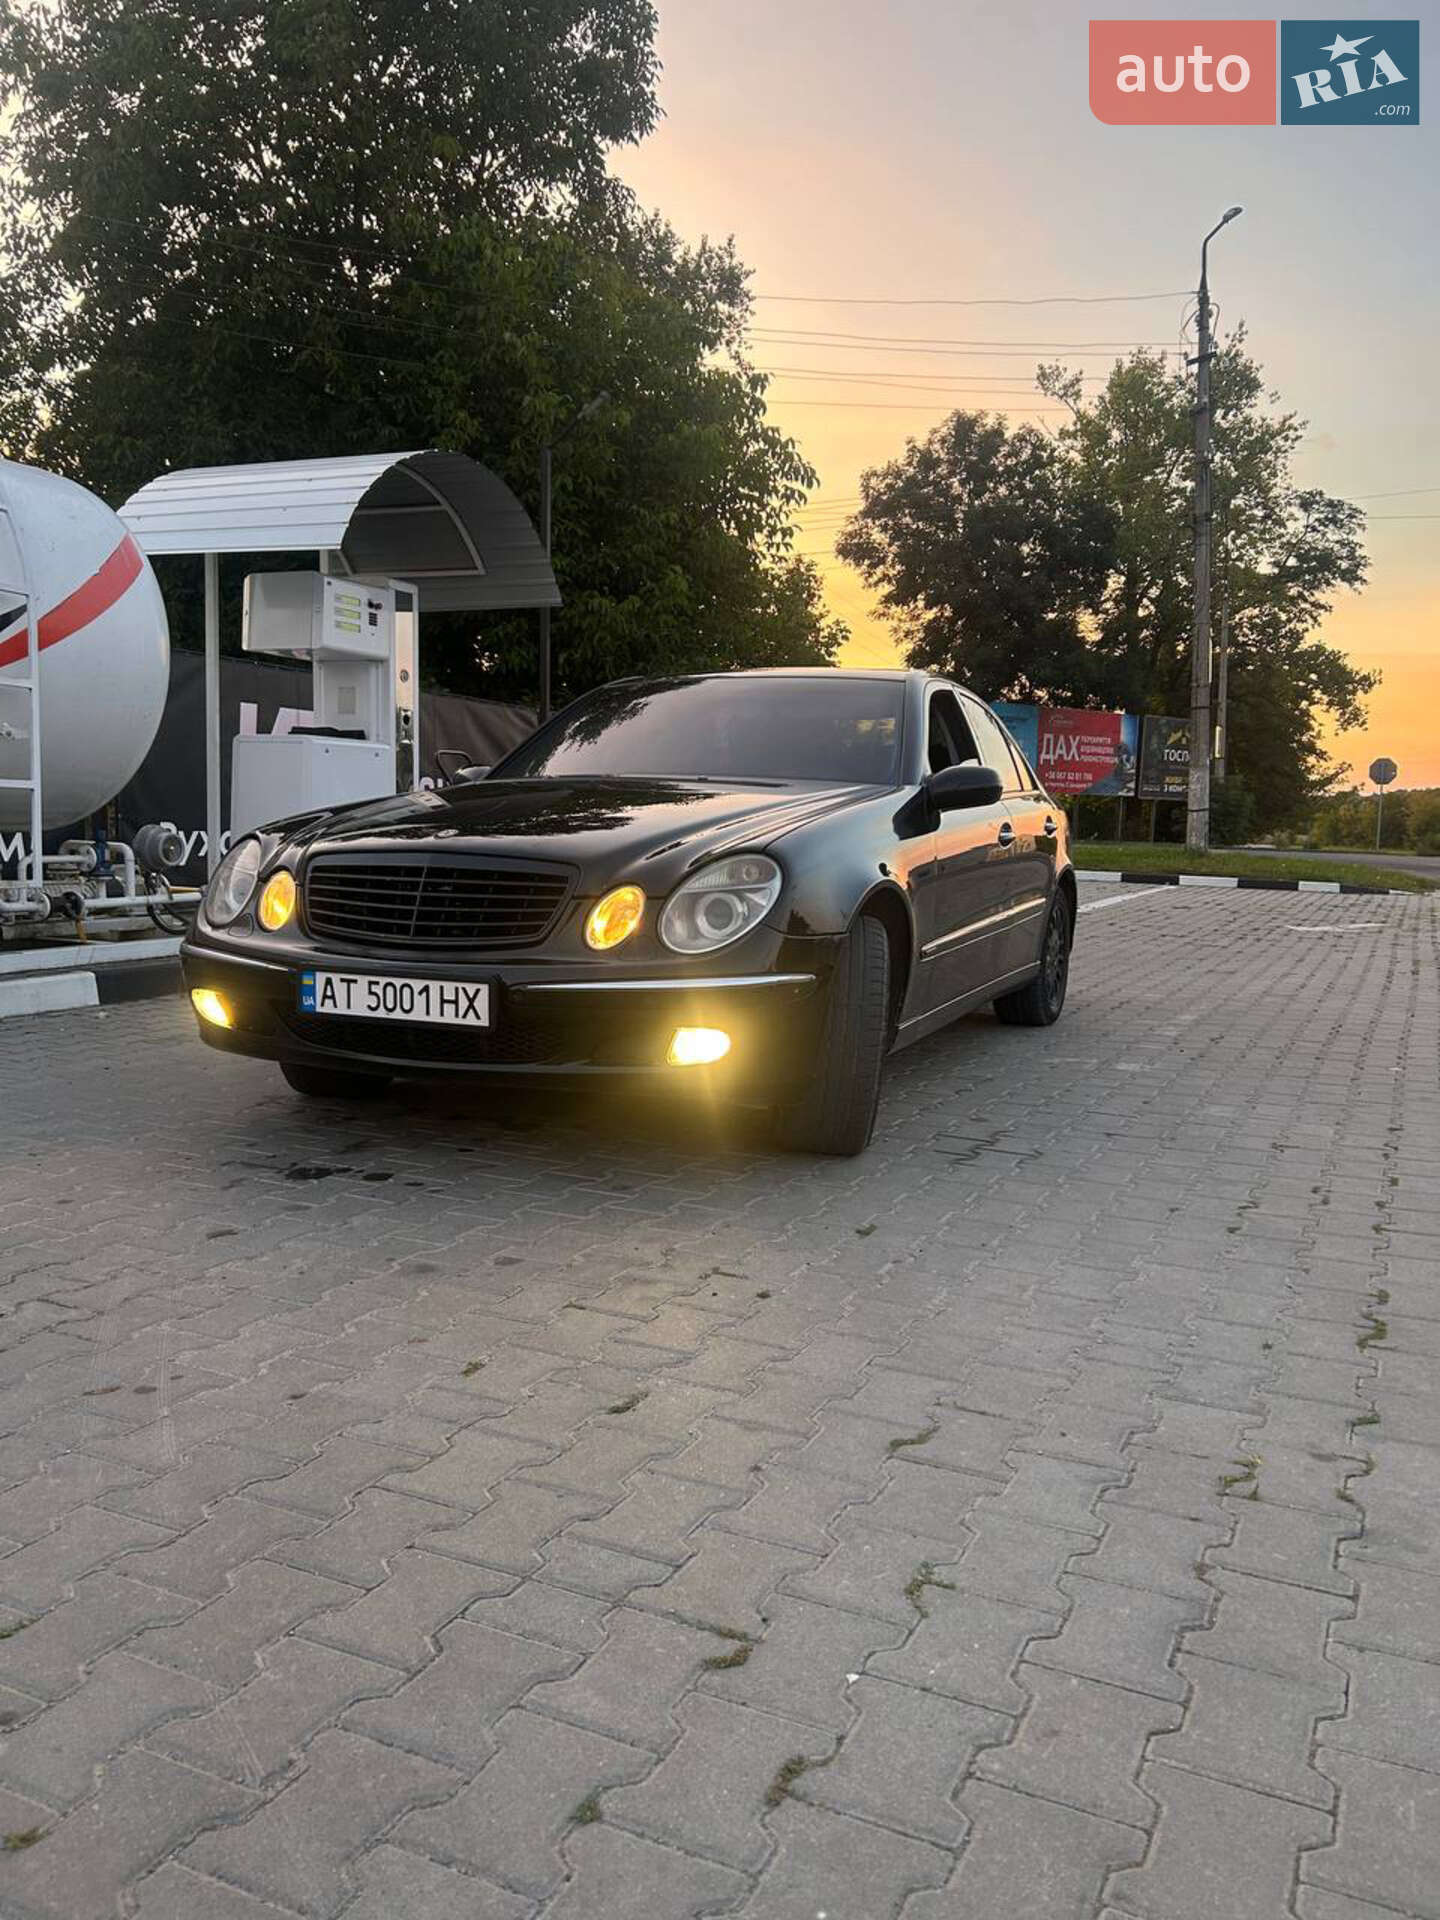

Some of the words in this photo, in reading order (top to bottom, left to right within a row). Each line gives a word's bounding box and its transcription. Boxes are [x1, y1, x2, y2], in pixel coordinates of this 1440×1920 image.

[1040, 733, 1080, 765] ДАХ
[320, 977, 358, 1009] AT
[367, 980, 430, 1016] 5001
[440, 985, 482, 1020] HX
